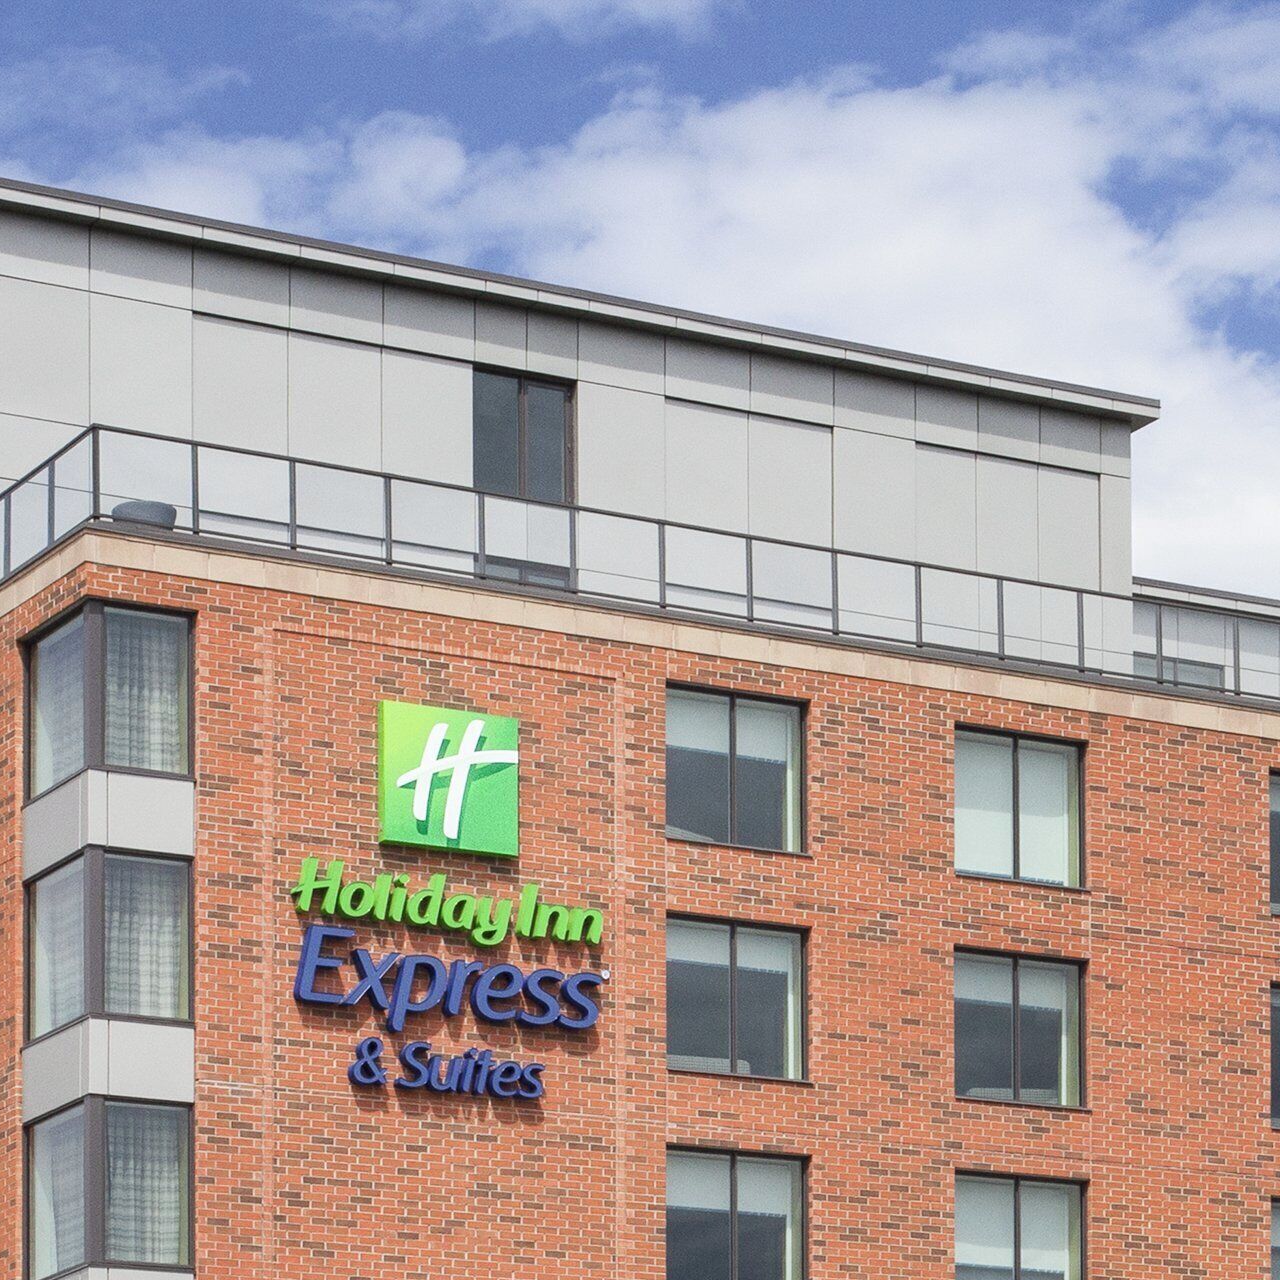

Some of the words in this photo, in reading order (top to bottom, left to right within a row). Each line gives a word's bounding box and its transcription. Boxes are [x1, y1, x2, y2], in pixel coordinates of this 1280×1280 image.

[291, 857, 512, 947] Holiday
[516, 883, 604, 946] Inn
[294, 925, 604, 1032] Express
[348, 1036, 387, 1086] &
[394, 1041, 546, 1099] Suites
